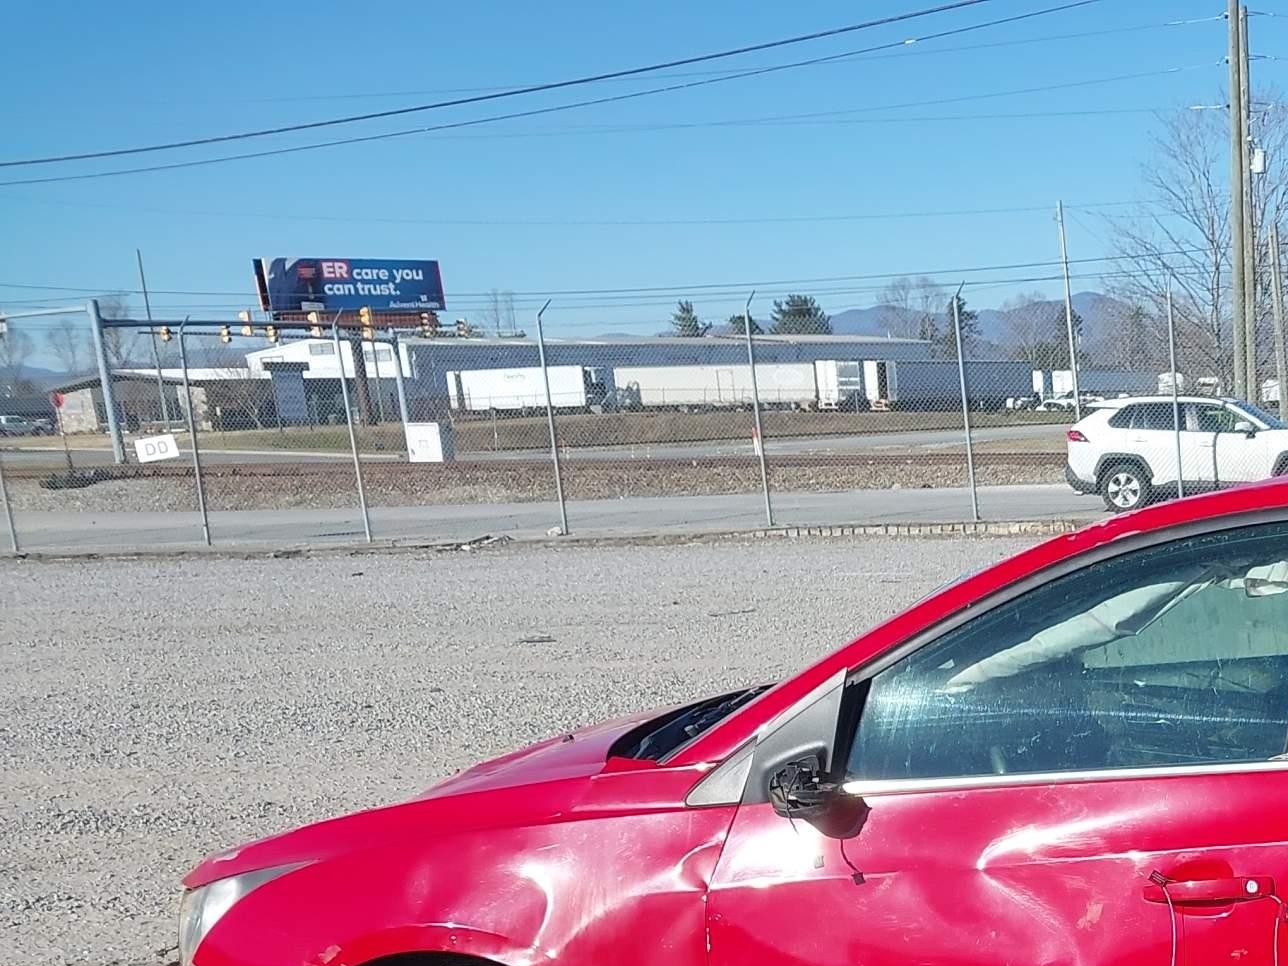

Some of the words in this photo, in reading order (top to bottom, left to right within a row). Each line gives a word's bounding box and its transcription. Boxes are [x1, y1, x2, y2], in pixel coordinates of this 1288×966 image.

[321, 262, 348, 278] ER
[353, 268, 389, 280] care
[393, 269, 424, 281] you
[323, 283, 355, 296] can
[358, 282, 401, 296] trust.
